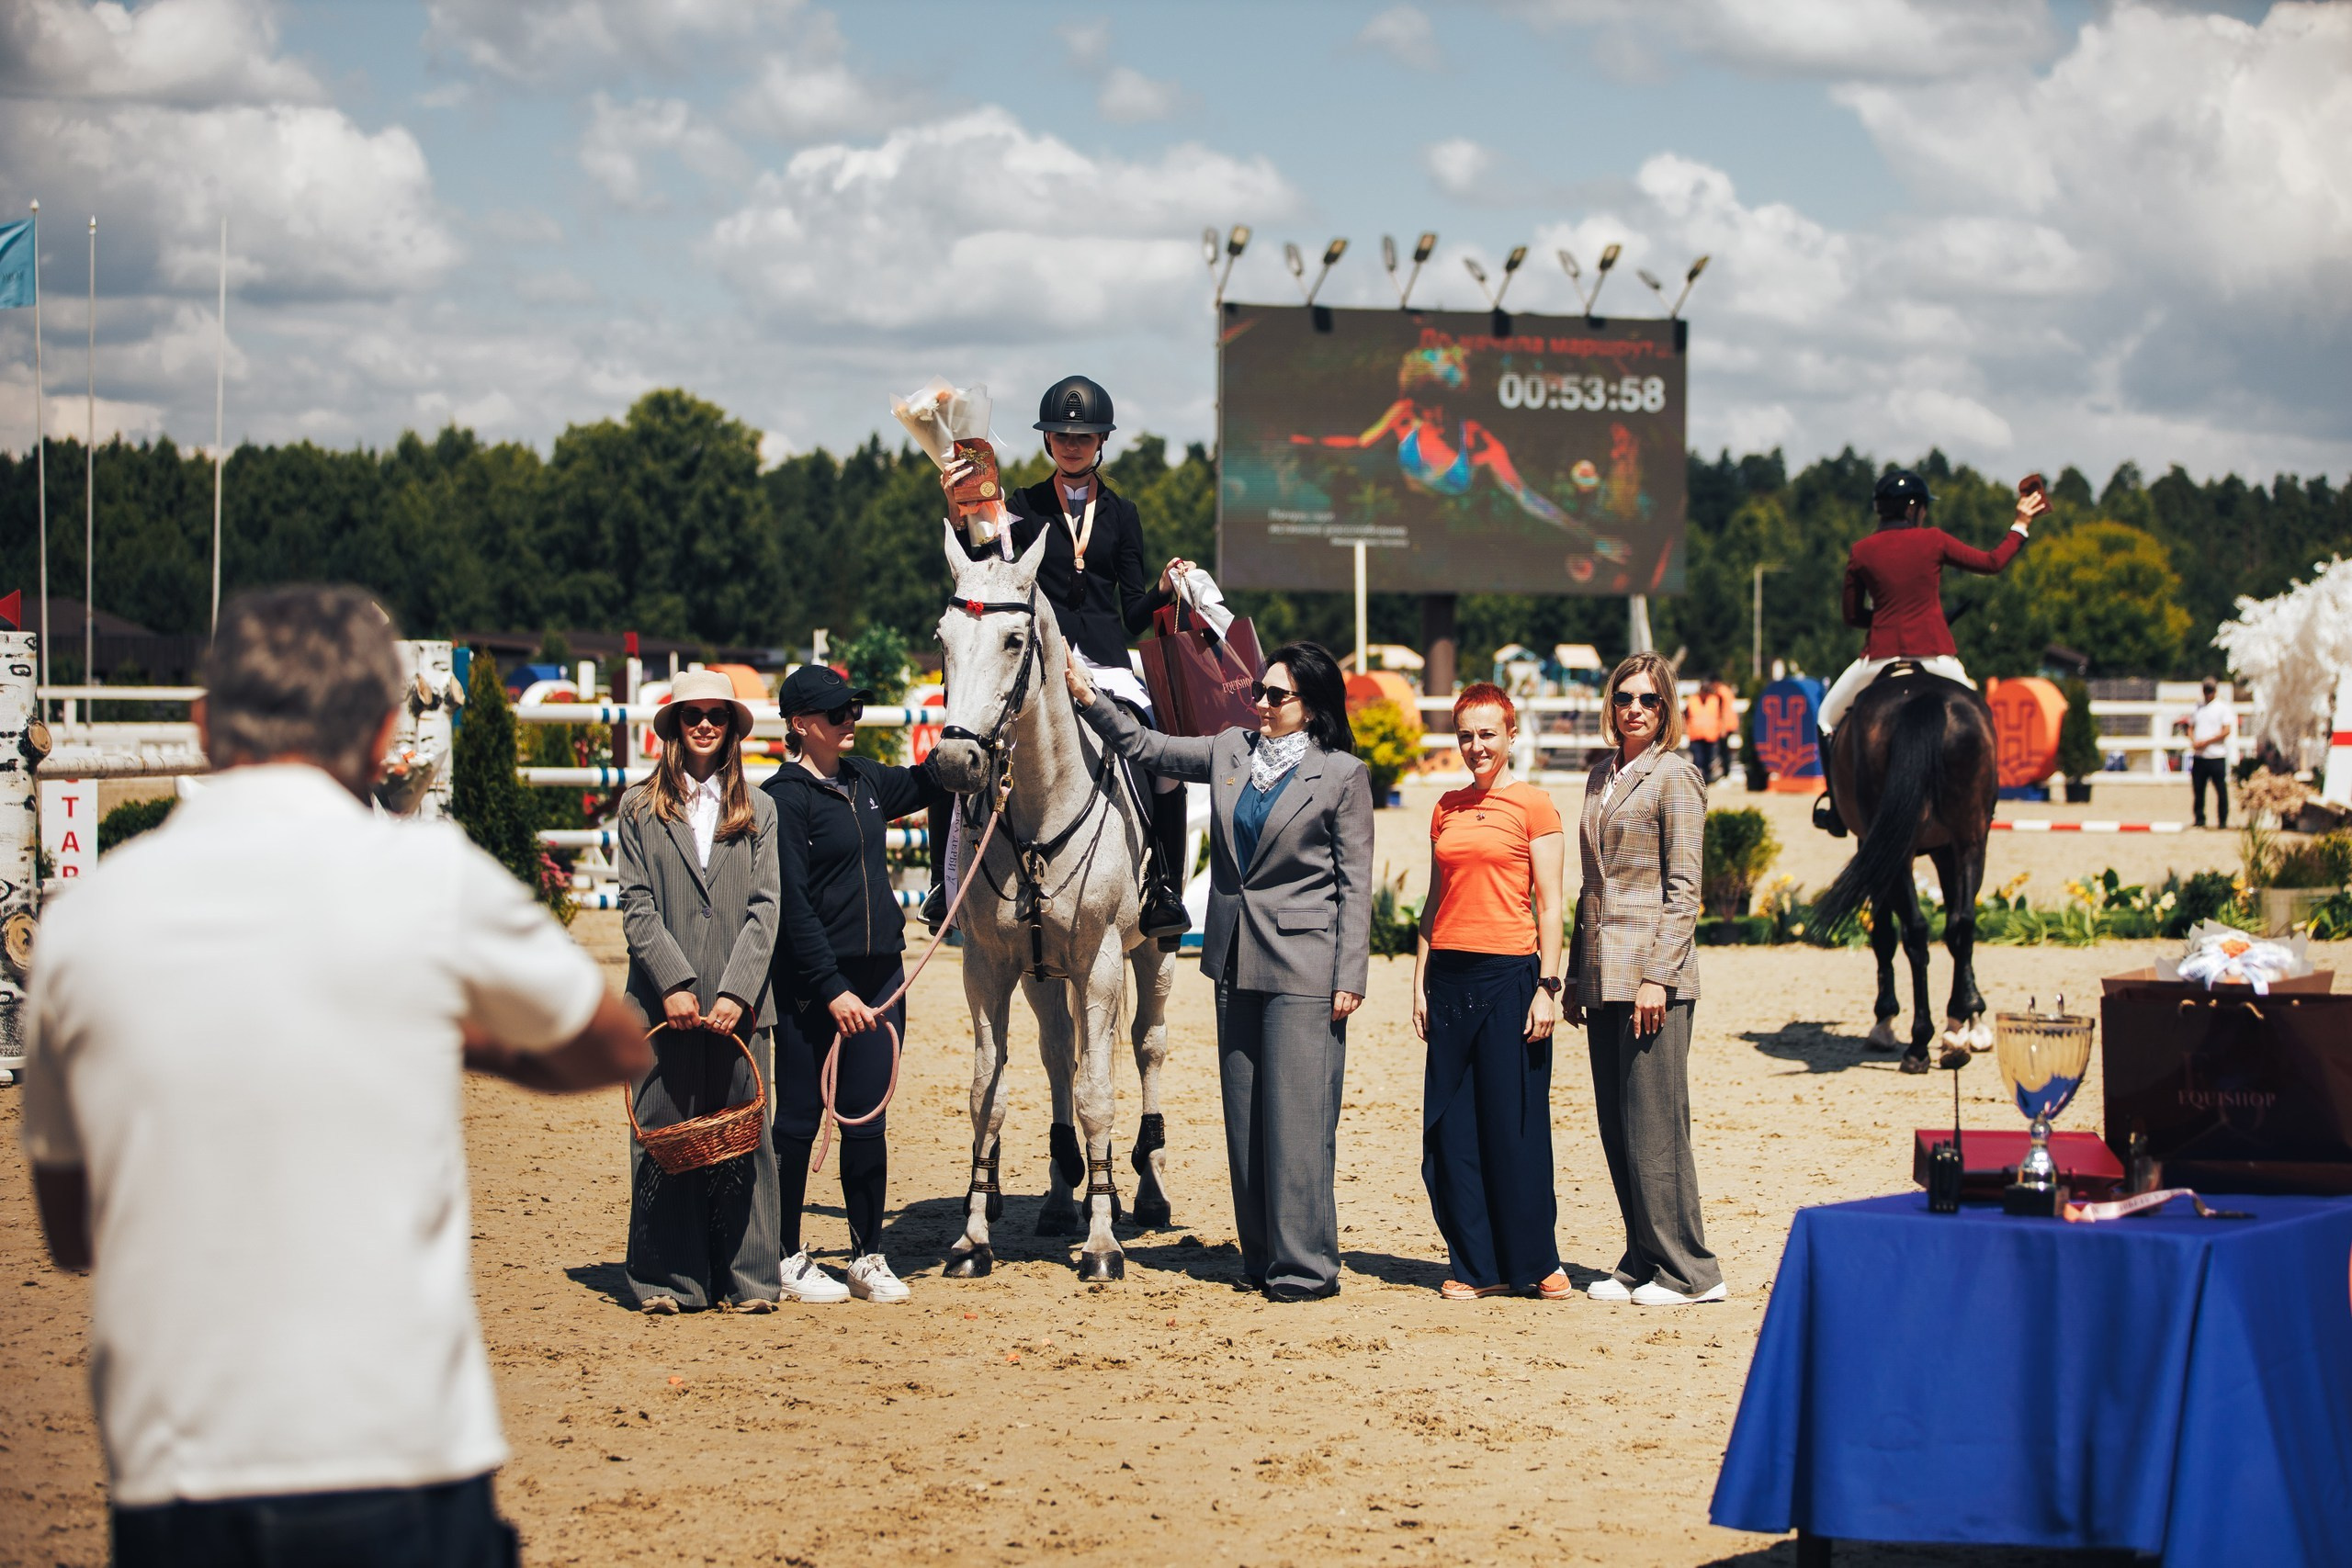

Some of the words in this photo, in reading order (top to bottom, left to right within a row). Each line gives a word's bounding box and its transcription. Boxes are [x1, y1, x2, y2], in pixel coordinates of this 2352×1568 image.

[1498, 374, 1665, 412] 00:53:58
[62, 780, 80, 877] TAR
[2178, 1090, 2277, 1110] EQUISHOP
